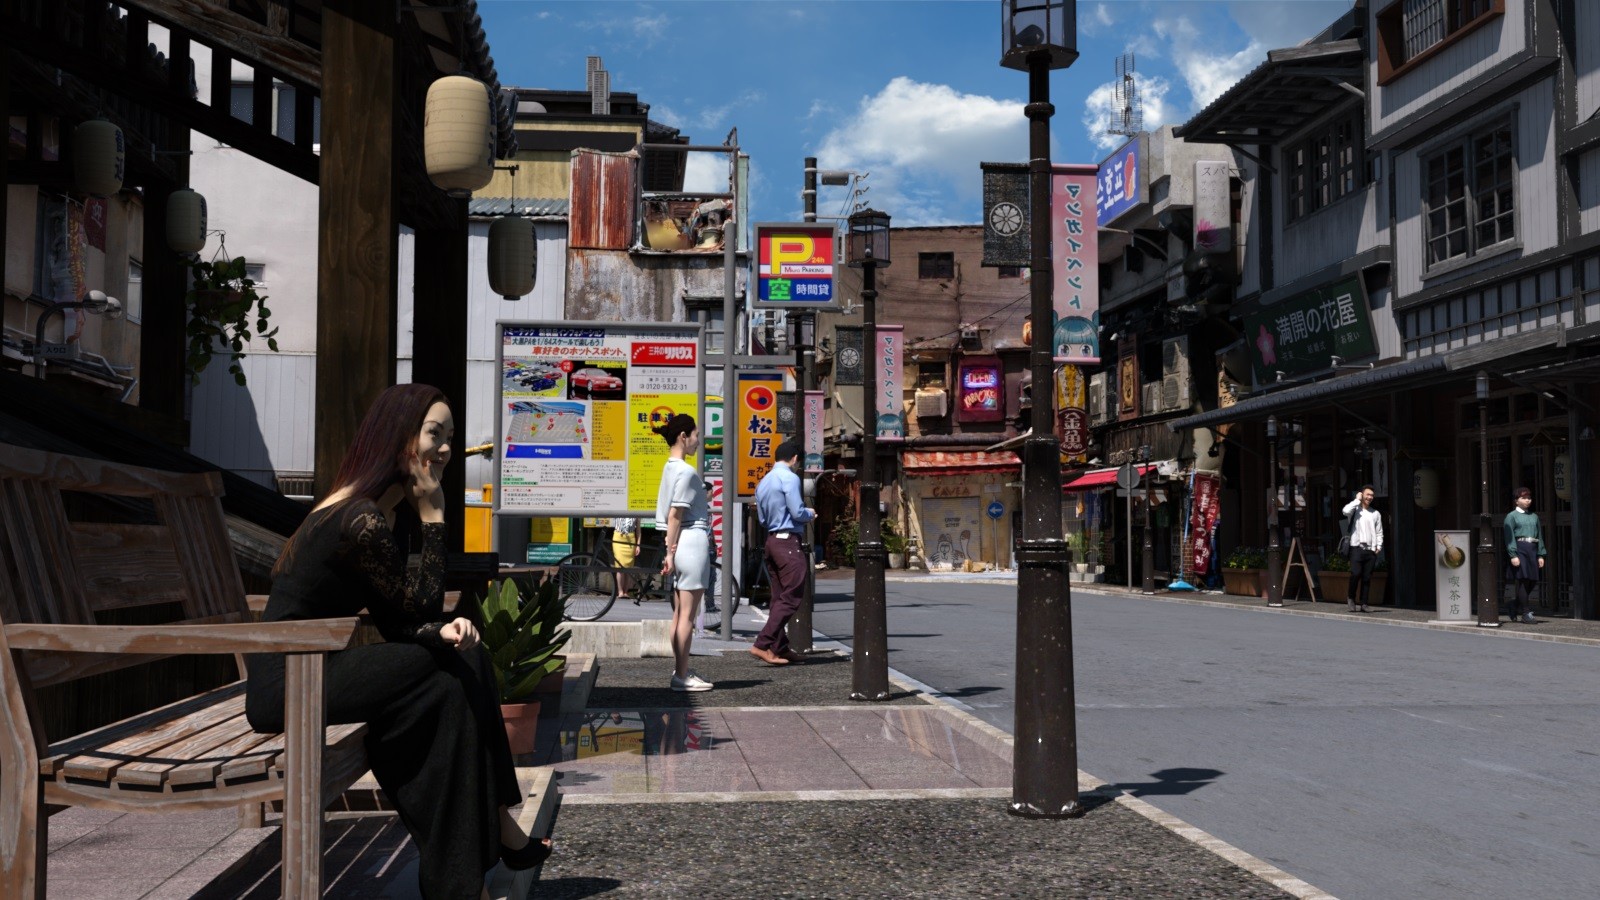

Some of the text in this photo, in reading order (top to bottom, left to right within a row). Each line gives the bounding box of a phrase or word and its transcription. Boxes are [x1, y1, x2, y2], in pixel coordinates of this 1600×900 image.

[1201, 165, 1227, 177] スパ
[770, 233, 815, 276] P
[1065, 183, 1083, 313] マンガイベント
[768, 278, 792, 300] 空
[796, 284, 829, 295] 時間貸
[1275, 293, 1358, 346] 満開の花屋
[1340, 332, 1360, 345] お祝い
[648, 346, 694, 360] 三井のリハウス
[883, 335, 895, 411] マンガイベント
[968, 372, 991, 384] OPEN
[963, 389, 995, 409] KARAOKE
[747, 414, 773, 458] 松屋
[810, 399, 819, 451] マンガイベント
[1063, 412, 1082, 447] 金魚
[747, 469, 756, 489] 定食
[1448, 576, 1461, 615] 喫茶店
